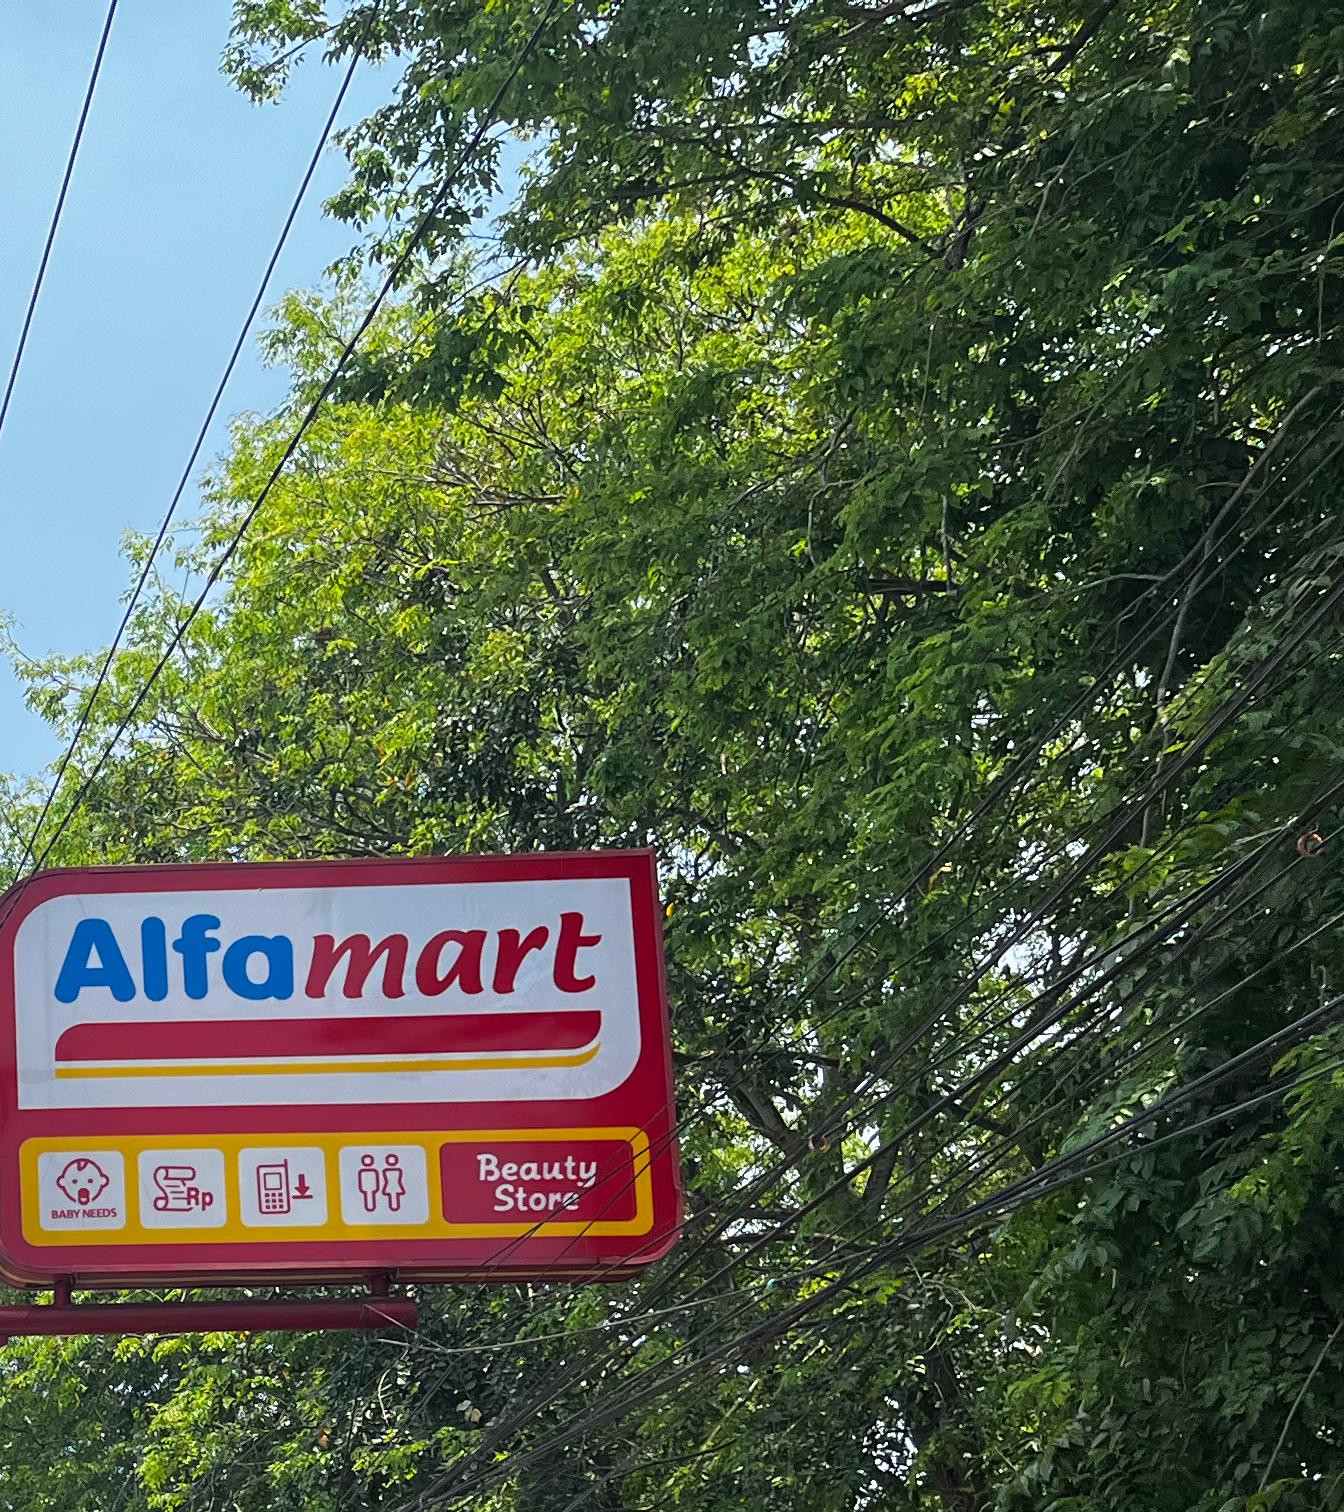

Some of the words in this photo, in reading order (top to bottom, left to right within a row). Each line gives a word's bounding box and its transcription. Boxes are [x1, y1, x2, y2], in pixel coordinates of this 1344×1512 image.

[54, 911, 601, 1004] Alfamart
[477, 1154, 597, 1188] Beauty
[186, 1187, 214, 1211] Rp
[494, 1184, 579, 1211] Store
[51, 1209, 80, 1219] BABY
[83, 1208, 117, 1218] NEEDS
